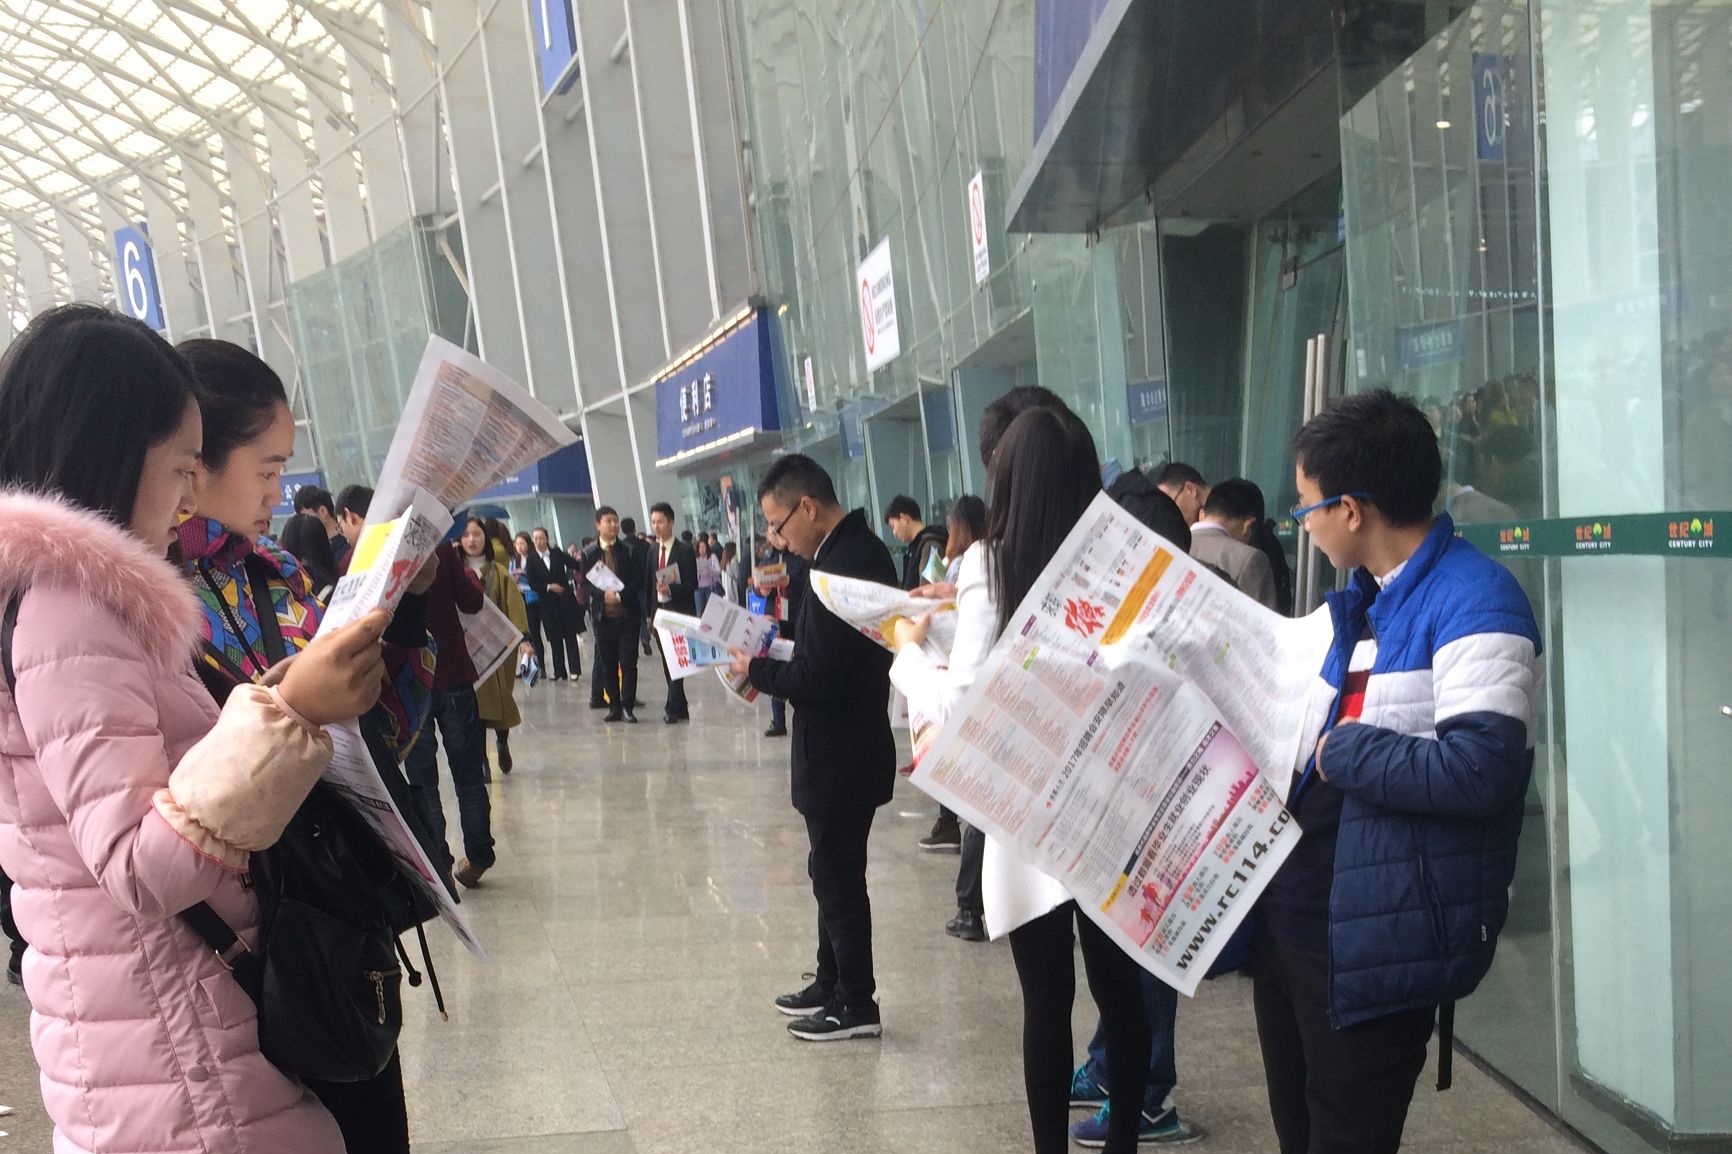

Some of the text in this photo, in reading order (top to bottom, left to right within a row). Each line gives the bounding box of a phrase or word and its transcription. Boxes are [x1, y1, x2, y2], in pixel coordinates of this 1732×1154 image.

[123, 241, 149, 321] 6
[680, 372, 713, 422] 便利店
[1575, 541, 1612, 550] CENTURY CITY
[1668, 540, 1714, 549] CENTURY CITY
